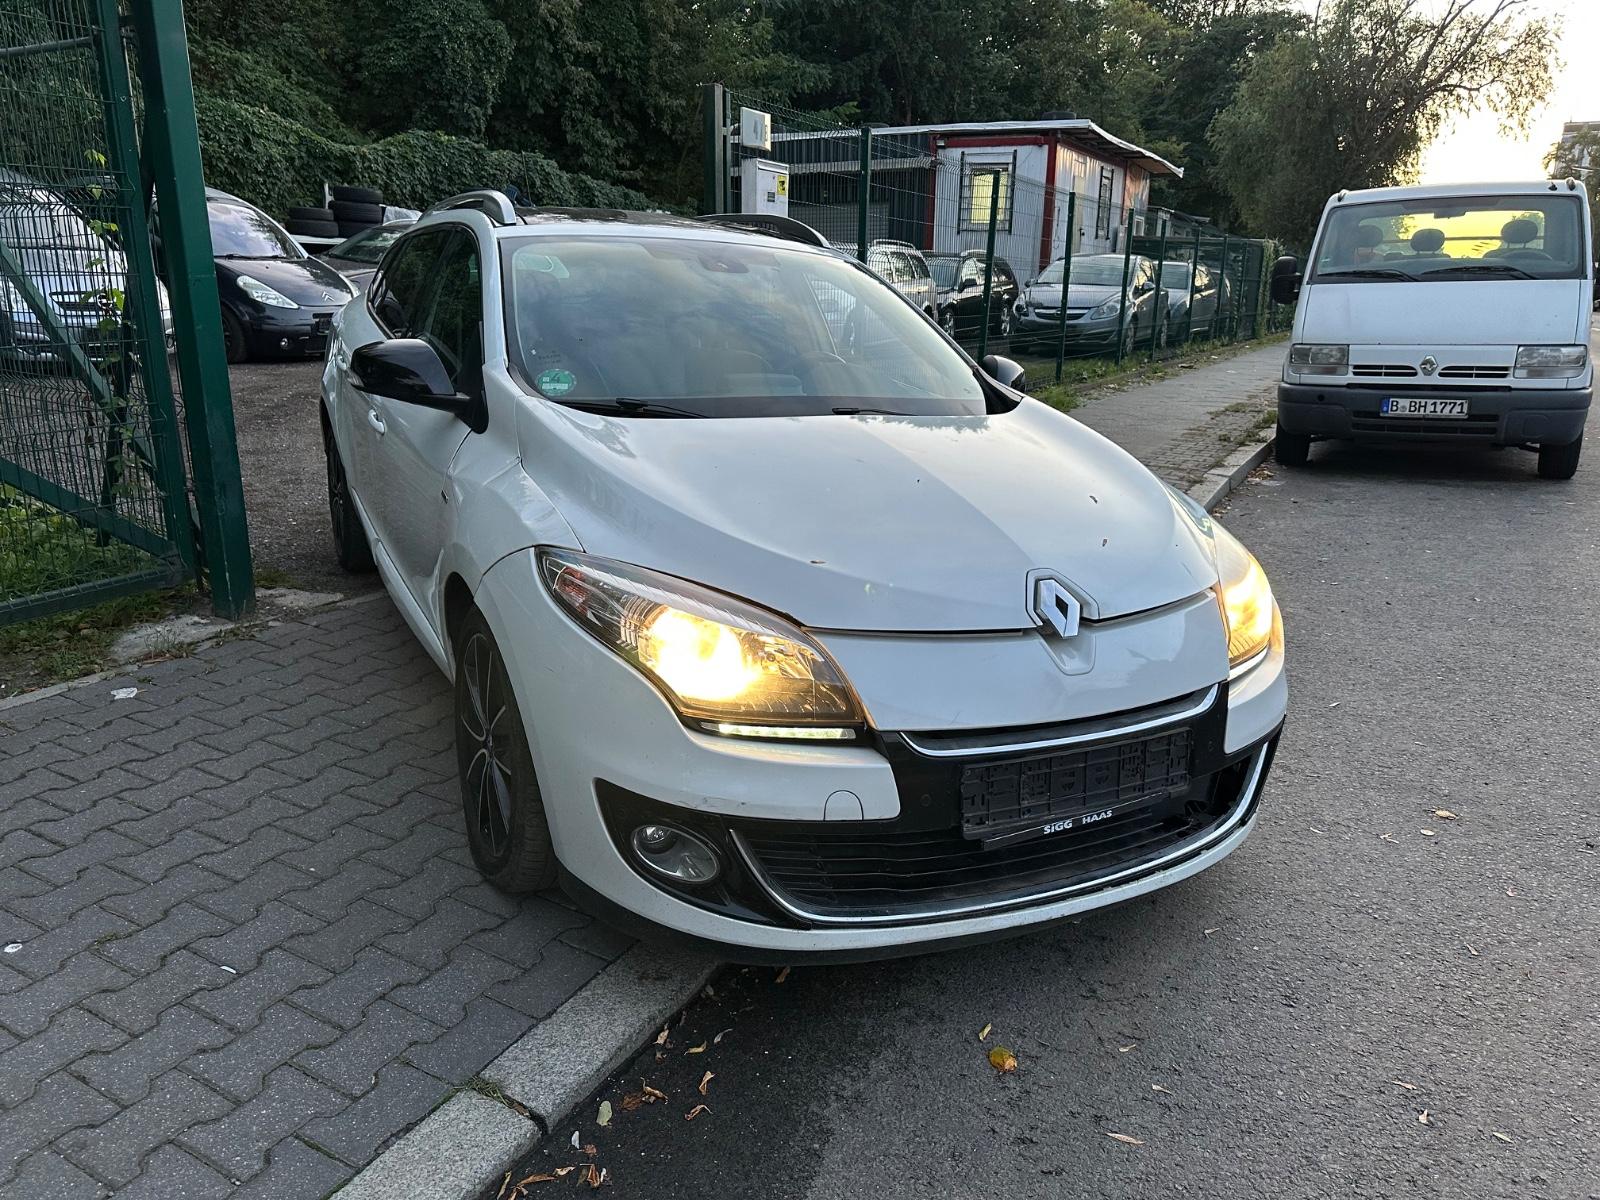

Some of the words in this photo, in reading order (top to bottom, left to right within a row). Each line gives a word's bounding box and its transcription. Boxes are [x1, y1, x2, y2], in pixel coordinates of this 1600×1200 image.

[550, 372, 561, 383] 4
[1390, 400, 1399, 412] B
[1408, 400, 1428, 413] BH
[1429, 401, 1465, 414] 1771
[1082, 810, 1113, 825] HAAS
